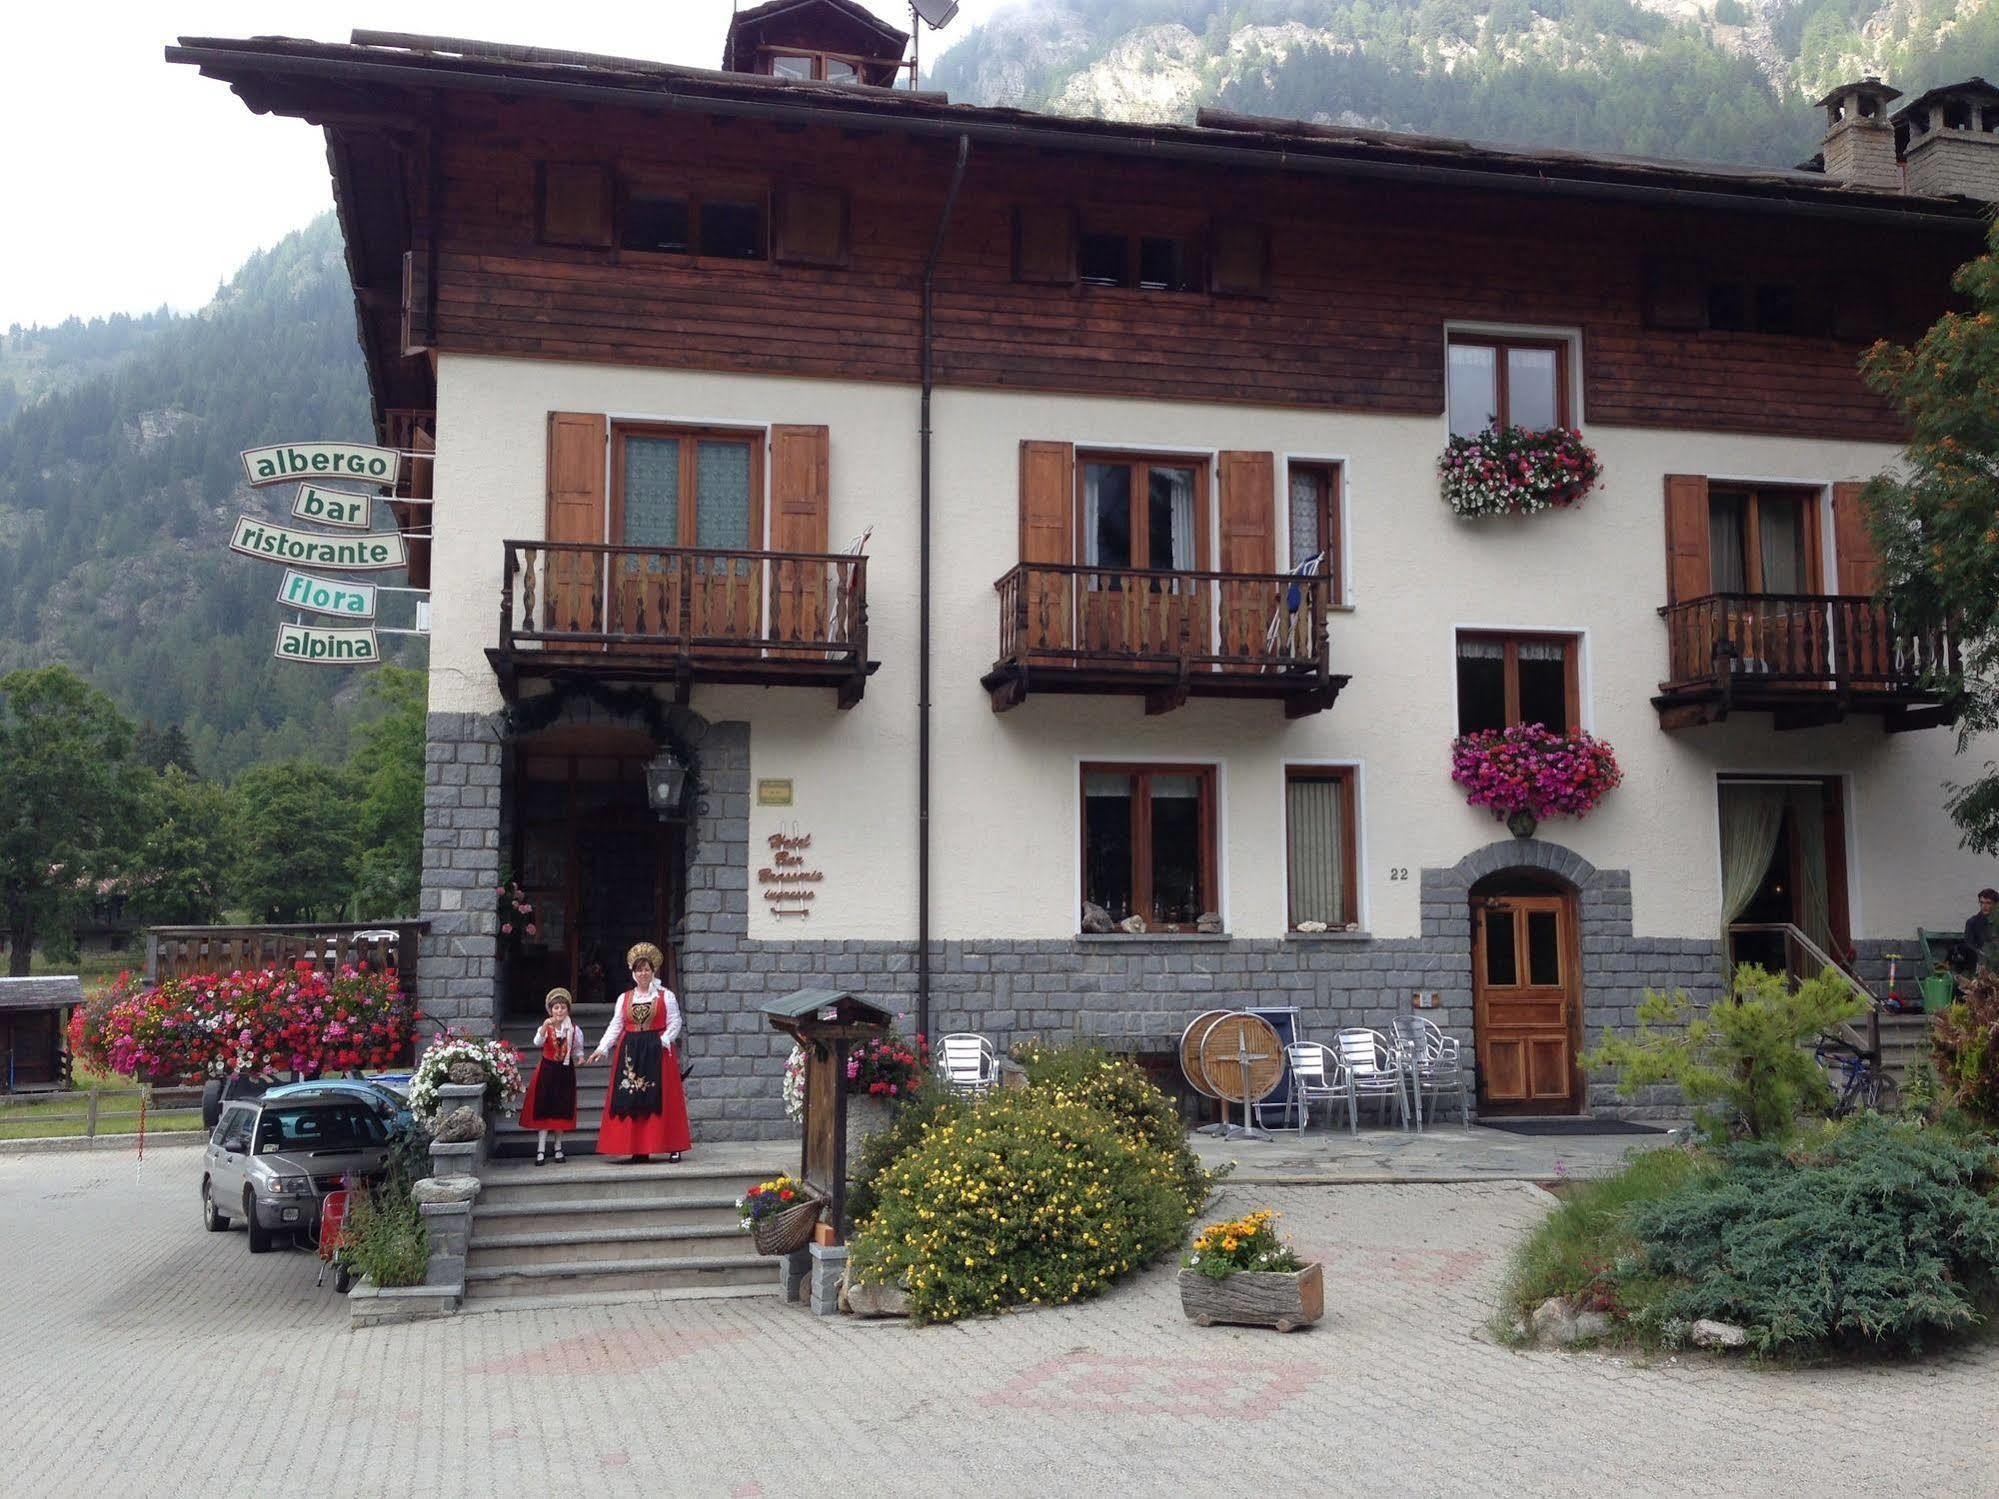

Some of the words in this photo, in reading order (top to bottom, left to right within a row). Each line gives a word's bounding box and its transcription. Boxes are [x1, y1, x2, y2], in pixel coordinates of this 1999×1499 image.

[256, 449, 387, 477] albergo
[304, 490, 361, 522] bar
[241, 527, 388, 564] ristorante
[288, 577, 364, 613] flora
[283, 632, 372, 659] alpina
[768, 833, 811, 849] Hotel
[1390, 867, 1408, 881] 22
